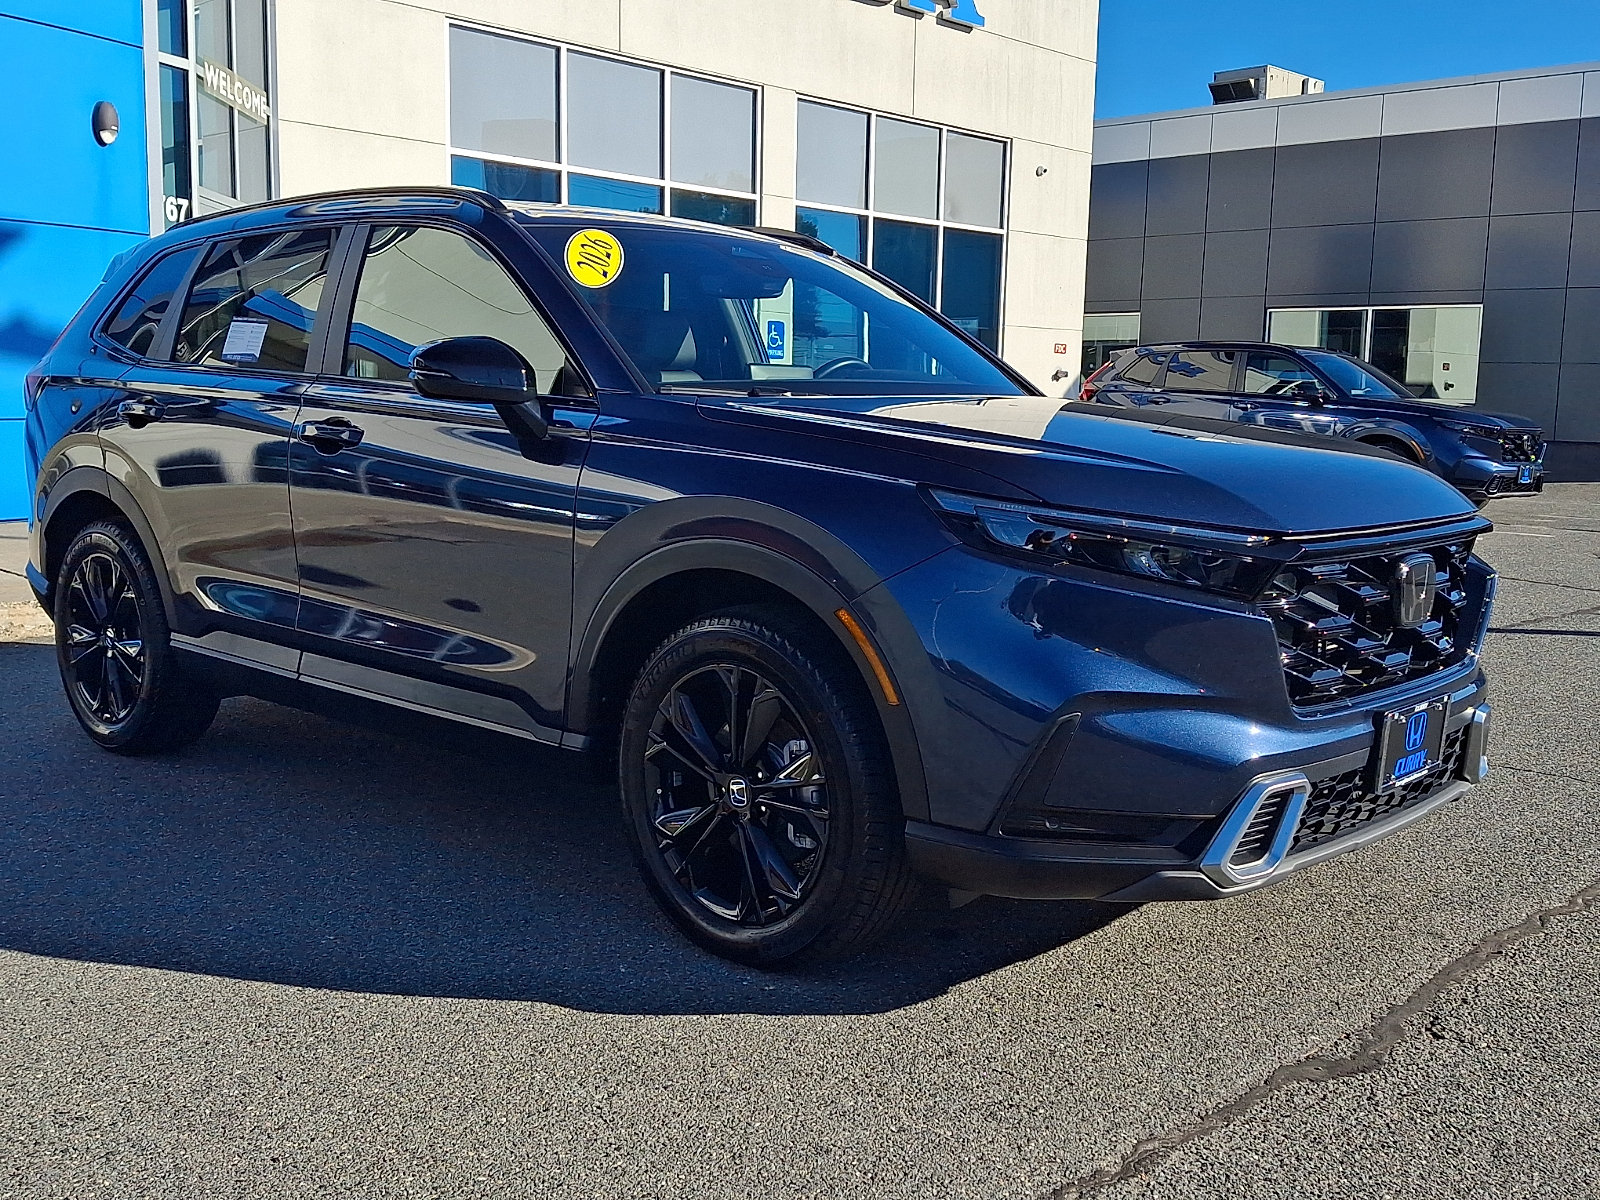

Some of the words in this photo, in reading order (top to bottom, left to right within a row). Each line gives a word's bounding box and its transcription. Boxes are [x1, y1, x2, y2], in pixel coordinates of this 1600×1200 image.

[204, 61, 267, 119] WELCOME
[163, 194, 189, 223] 67
[576, 233, 613, 279] 2026
